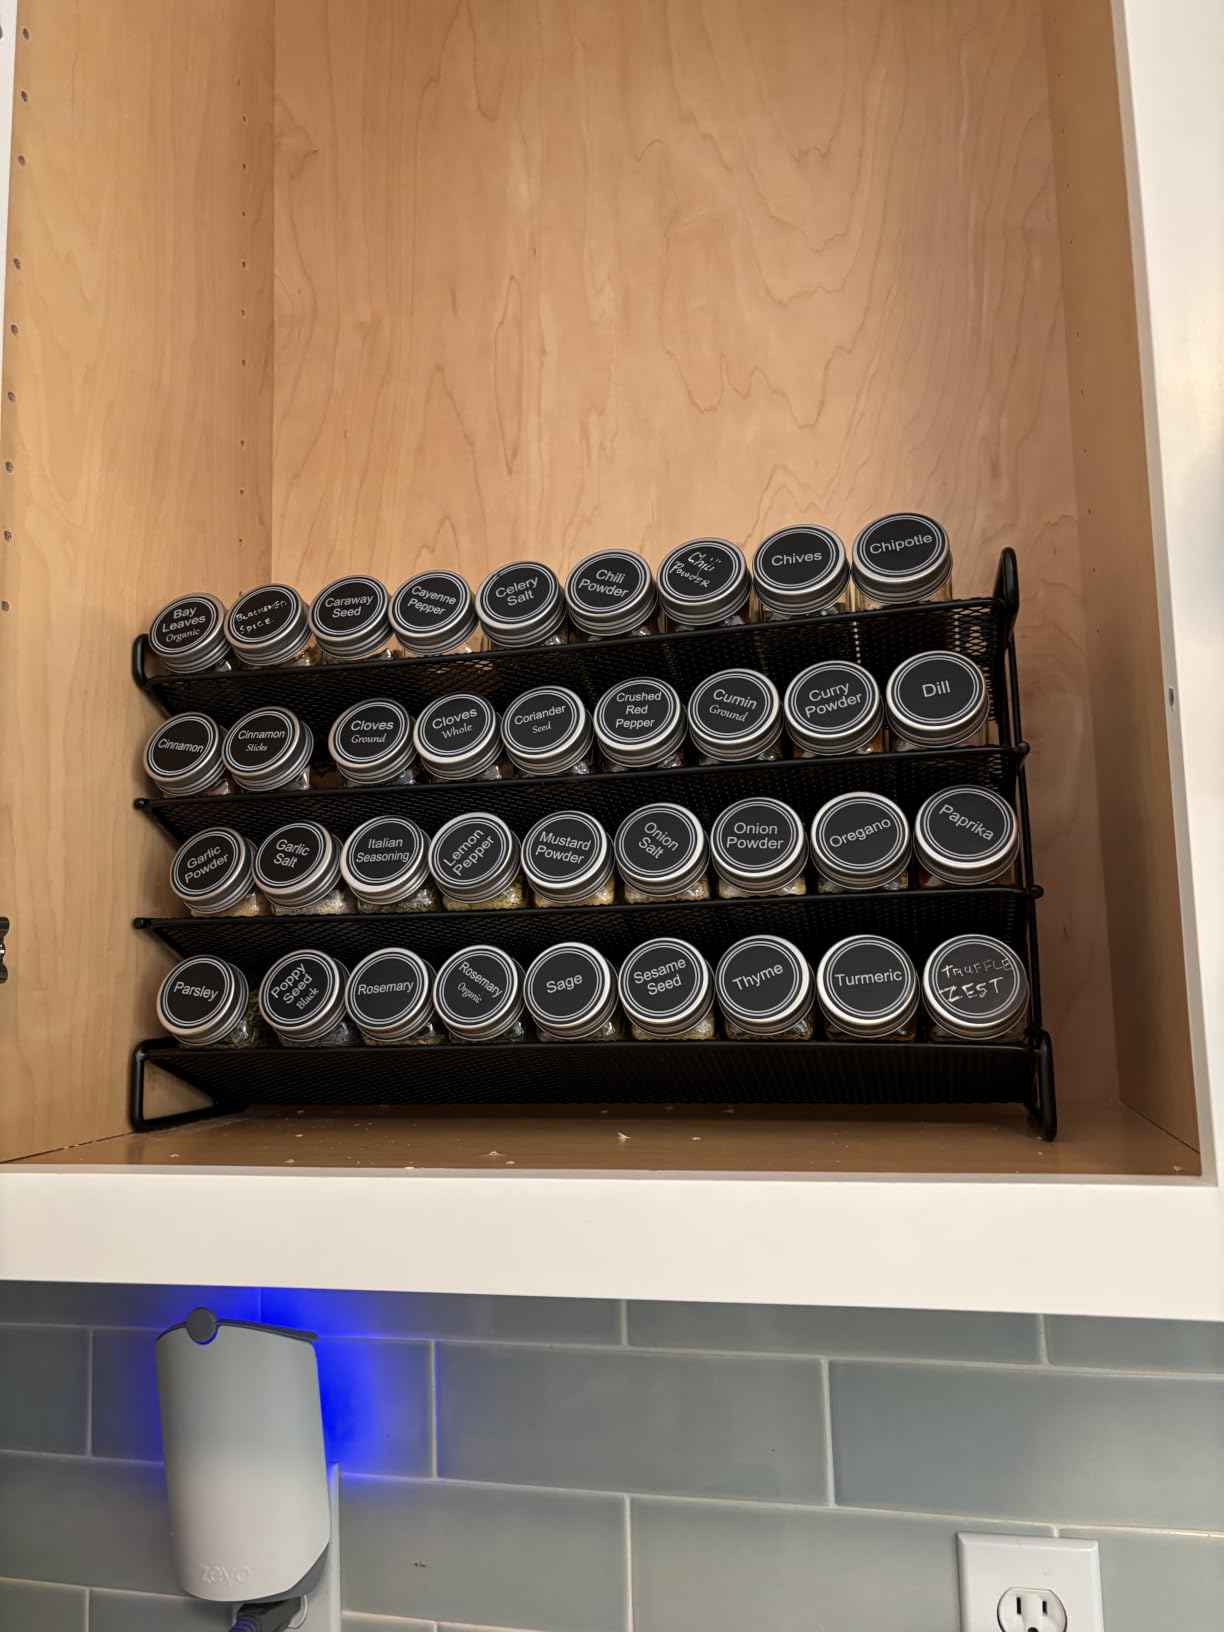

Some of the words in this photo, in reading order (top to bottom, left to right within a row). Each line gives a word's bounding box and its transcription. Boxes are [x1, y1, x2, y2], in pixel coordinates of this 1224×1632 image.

[869, 533, 933, 555] Chipotle
[771, 551, 822, 566] Chives
[595, 569, 626, 584] Chili
[411, 585, 457, 606] Cayenne
[495, 576, 539, 599] Celery
[578, 579, 629, 598] Powder
[324, 594, 375, 608] Caraway
[407, 599, 446, 615] Pepper
[507, 590, 535, 607] Salt
[173, 607, 198, 619] Bay
[331, 607, 361, 619] Seed
[162, 614, 206, 633] Leaves
[165, 628, 200, 643] Organic
[616, 692, 662, 703] Crushed
[808, 682, 850, 702] Curry
[922, 680, 951, 698] Dill
[712, 689, 758, 710] Cumin
[804, 692, 862, 718] Powder
[431, 708, 478, 730] Cloves
[514, 705, 566, 726] Coriander
[625, 705, 648, 715] Red
[708, 704, 748, 722] Ground
[350, 720, 394, 731] Cloves
[441, 723, 473, 739] Whole
[532, 721, 552, 734] Seed
[615, 717, 655, 730] Pepper
[237, 730, 286, 740] Cinnamon
[351, 733, 386, 744] Ground
[157, 738, 204, 752] Cinnamon
[245, 743, 268, 752] Sticks
[734, 822, 778, 834] Onion
[938, 804, 994, 841] Paprika
[539, 832, 592, 850] Mustard
[644, 822, 679, 851] Onion
[829, 818, 891, 848] Oregano
[275, 839, 311, 857] Garlic
[367, 838, 403, 848] Italian
[443, 828, 484, 867] Lemon
[638, 837, 665, 860] Salt
[726, 837, 785, 849] Powder
[186, 846, 221, 869] Garlic
[272, 853, 298, 868] Salt
[355, 851, 410, 863] Seasoning
[452, 835, 495, 877] Pepper
[535, 845, 585, 864] Powder
[184, 853, 230, 884] Powder
[458, 961, 503, 998] Rosemary
[633, 958, 687, 984] Sesame
[732, 963, 784, 991] Thyme
[834, 969, 903, 987] Turmeric
[270, 963, 306, 999] Poppy
[283, 974, 313, 1004] Seed
[357, 980, 414, 995] Rosemary
[546, 974, 583, 994] Sage
[647, 974, 682, 996] Seed
[939, 977, 1004, 1002] ZEST
[173, 981, 220, 1002] Parsley
[296, 987, 320, 1011] Black
[457, 981, 482, 1004] Organic
